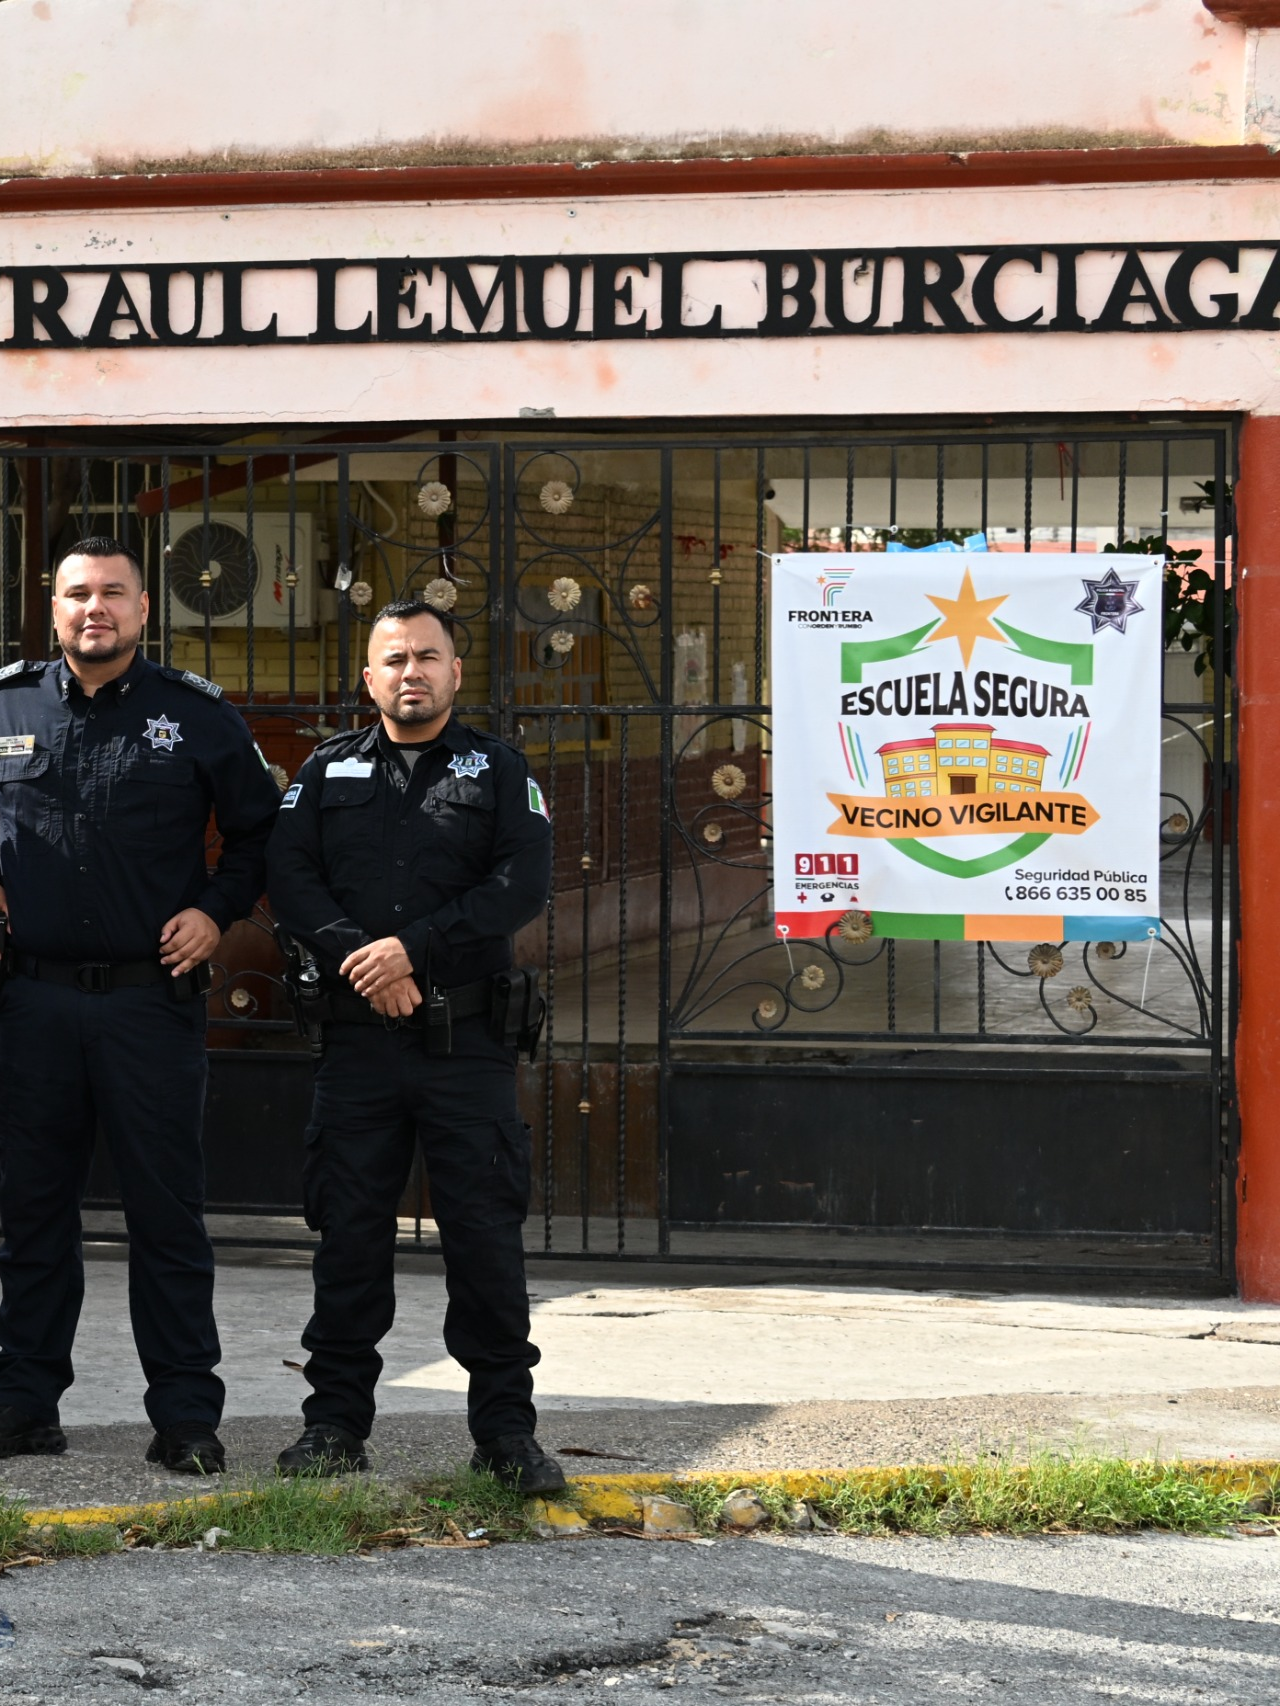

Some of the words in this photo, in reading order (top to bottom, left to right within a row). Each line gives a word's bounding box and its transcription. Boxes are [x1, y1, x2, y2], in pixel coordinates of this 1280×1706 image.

[4, 262, 278, 348] RAUL
[307, 254, 722, 342] LEMUEL
[788, 610, 874, 622] FRONTERA
[841, 671, 969, 716] ESCUELA
[974, 671, 1090, 718] SEGURA
[841, 803, 942, 829] VECINO
[949, 801, 1087, 827] VIGILANTE
[797, 855, 854, 874] 911
[1015, 868, 1090, 884] Seguridad
[1094, 869, 1147, 884] Pública
[795, 881, 860, 890] EMERGENCIAS
[1016, 886, 1052, 901] 866
[1056, 886, 1091, 901] 635
[1096, 887, 1120, 901] 00
[1124, 888, 1147, 903] 85
